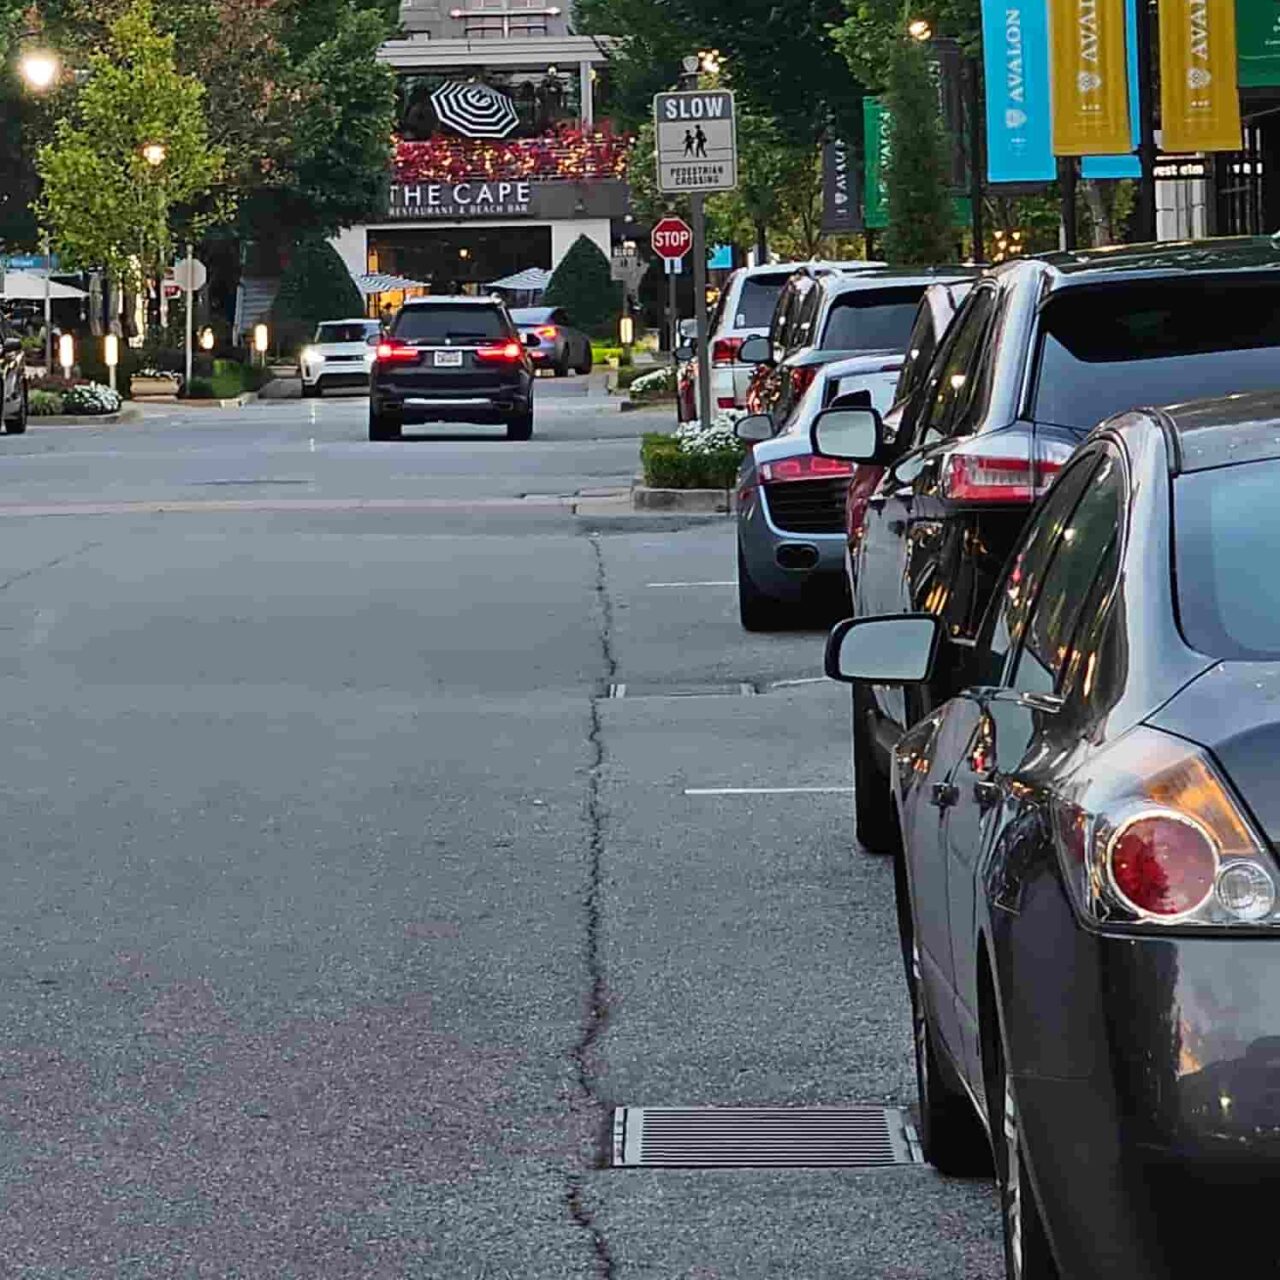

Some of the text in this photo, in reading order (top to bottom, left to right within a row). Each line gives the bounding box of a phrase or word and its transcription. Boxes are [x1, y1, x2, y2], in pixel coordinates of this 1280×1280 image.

[1005, 8, 1024, 102] AVALON
[665, 97, 723, 119] SLOW
[670, 165, 724, 178] PEDESTRIAN
[675, 175, 720, 186] CROSSING
[389, 182, 530, 206] THE CAPE
[469, 204, 503, 214] BEACH
[507, 203, 528, 213] BAR
[655, 231, 689, 247] STOP
